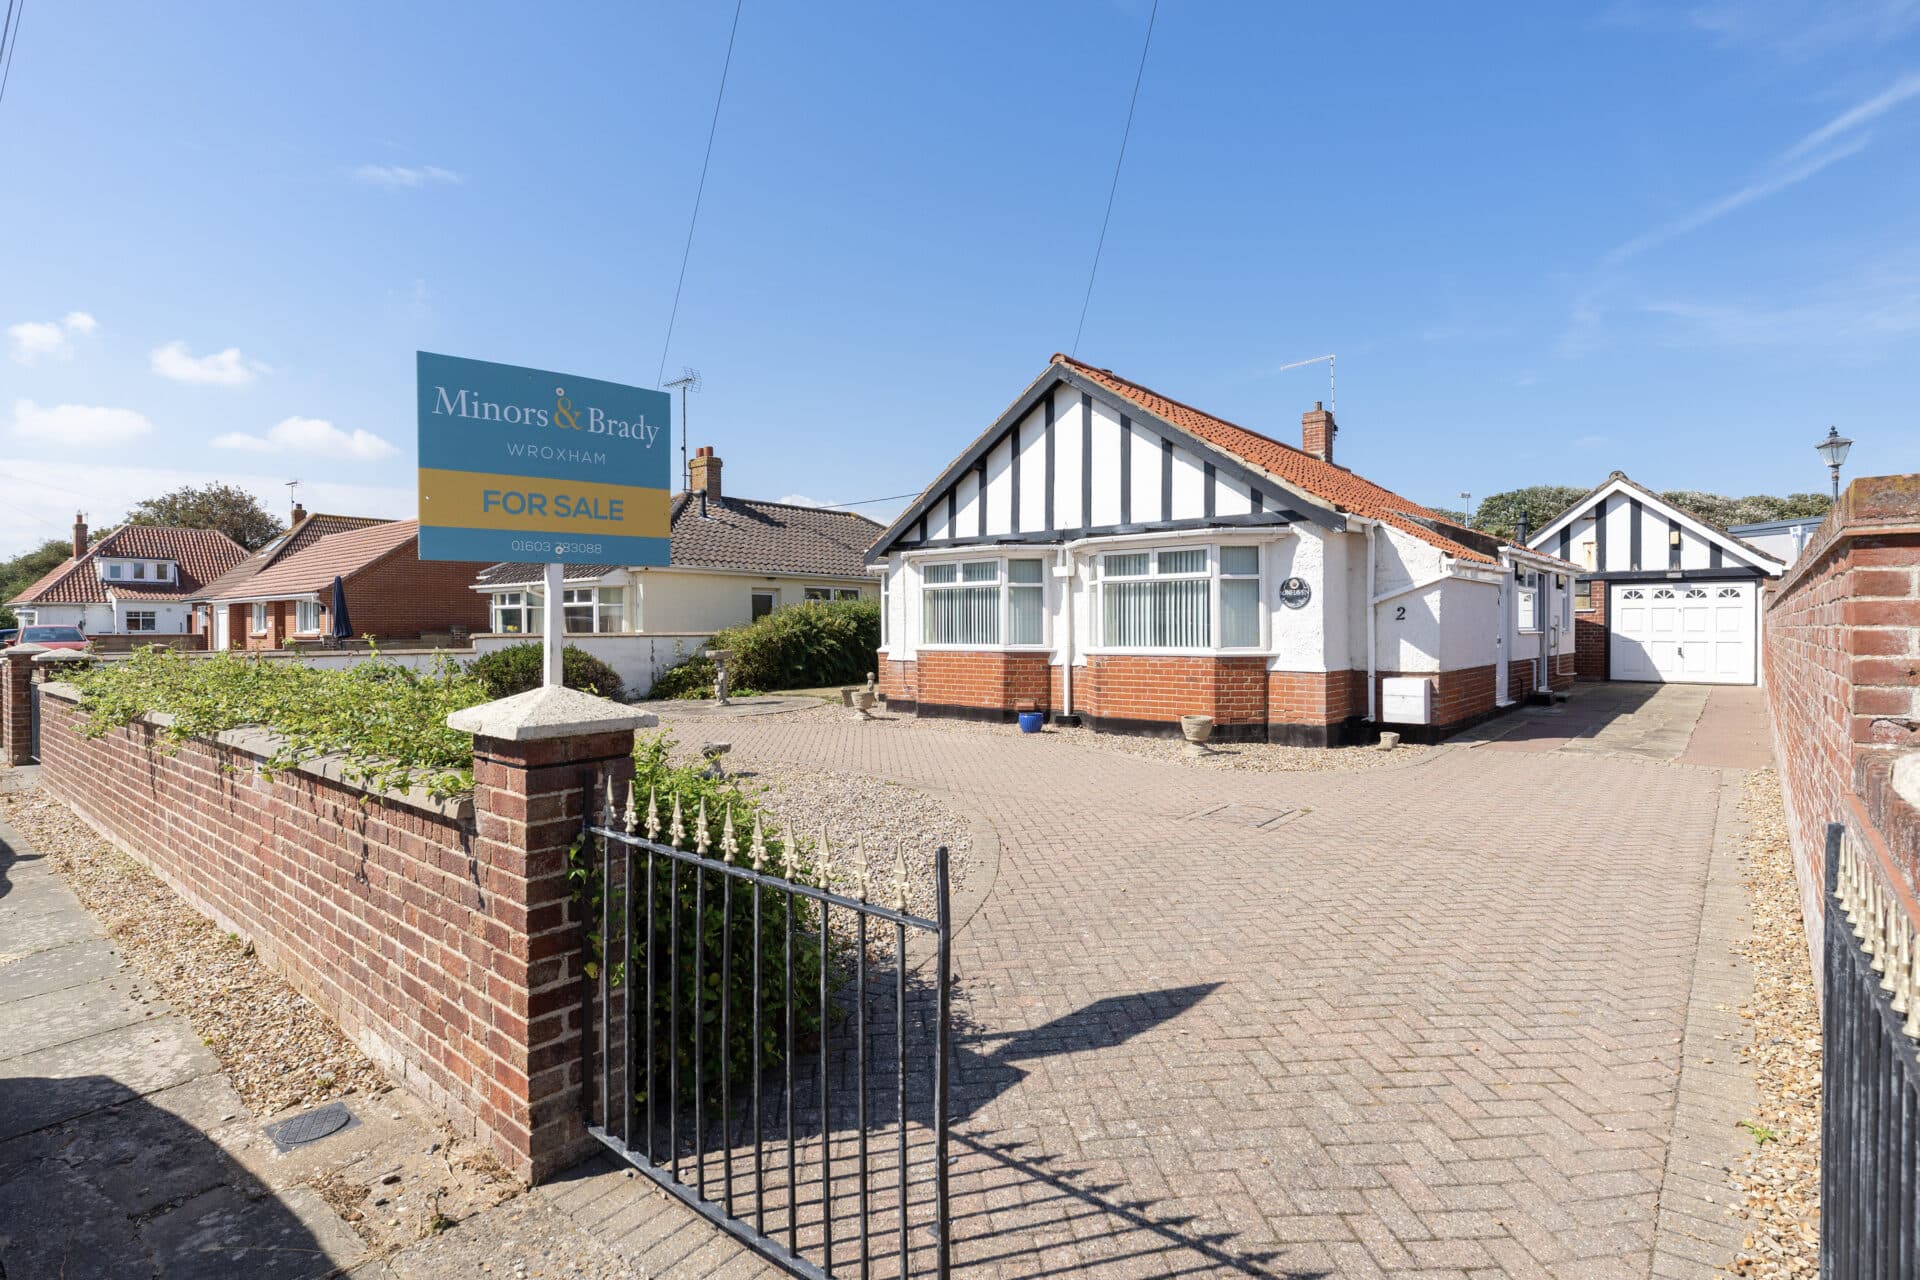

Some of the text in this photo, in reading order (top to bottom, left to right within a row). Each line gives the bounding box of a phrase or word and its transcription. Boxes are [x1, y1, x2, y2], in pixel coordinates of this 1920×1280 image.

[432, 386, 660, 449] Minors & Brady
[507, 442, 606, 465] WROXHAM
[482, 489, 625, 521] FOR SALE
[511, 540, 551, 552] 01603
[1395, 606, 1406, 621] 2
